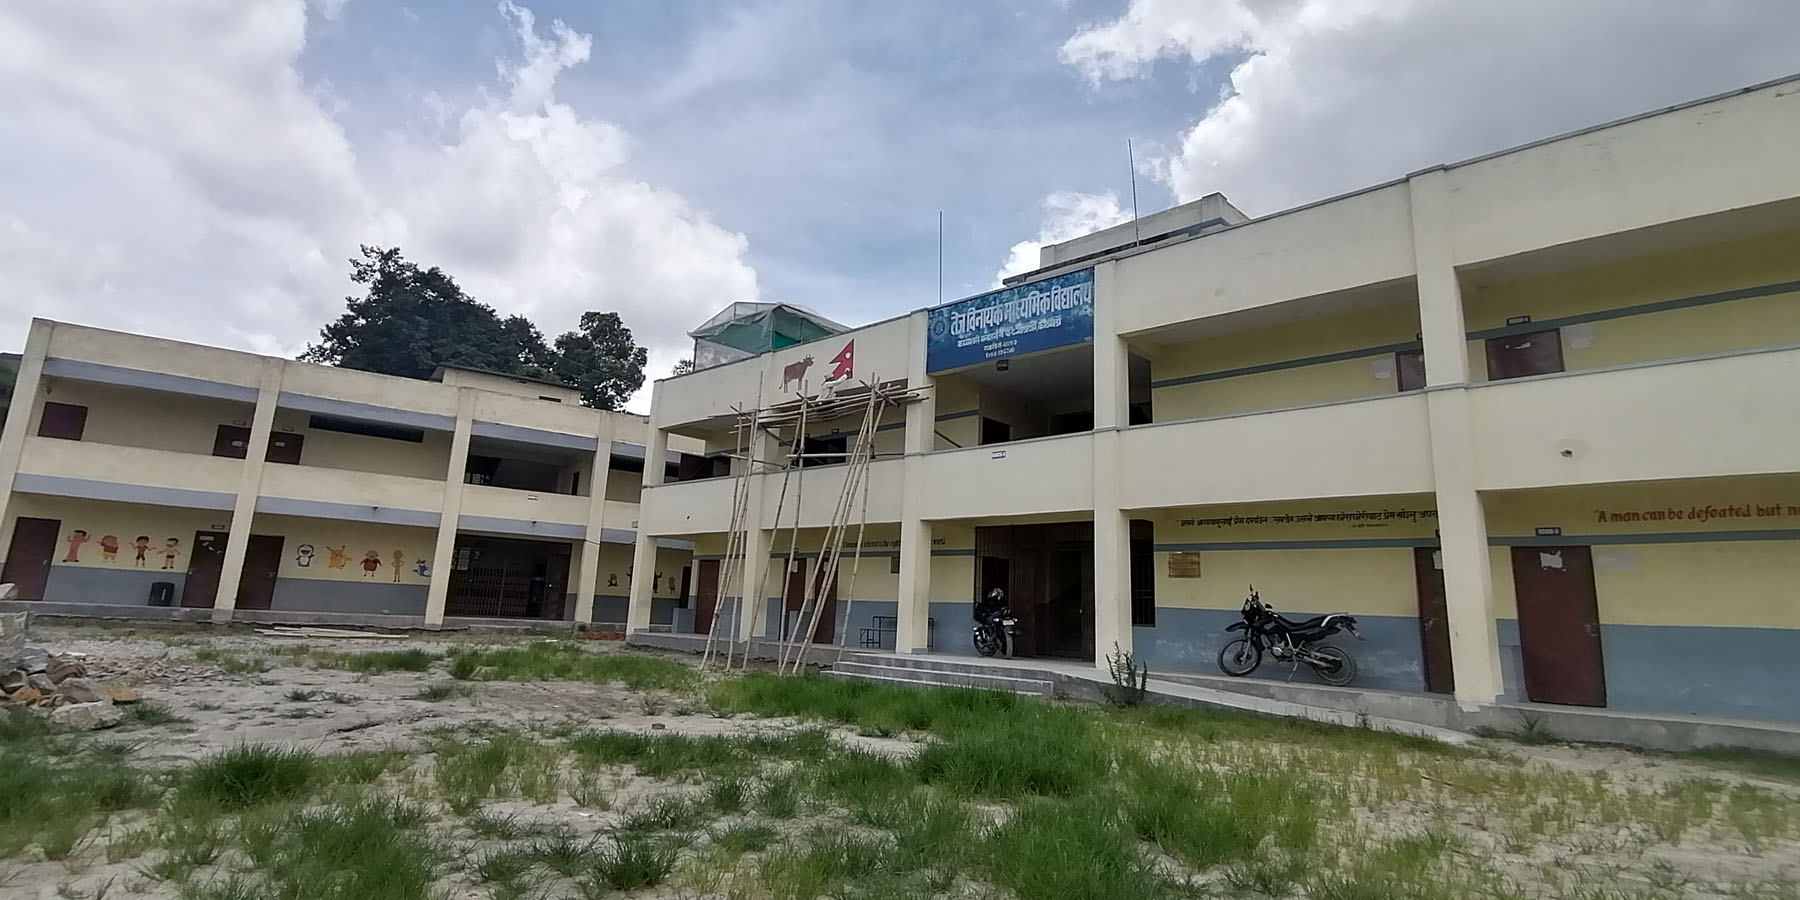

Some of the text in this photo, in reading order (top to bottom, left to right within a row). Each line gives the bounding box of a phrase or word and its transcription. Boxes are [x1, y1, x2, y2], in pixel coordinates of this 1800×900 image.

[950, 311, 966, 336] तेज
[966, 304, 1003, 332] विनायक
[1004, 291, 1051, 323] माध्यमिक
[1051, 281, 1092, 313] विद्यालय
[1610, 511, 1640, 522] man
[1641, 510, 1666, 521] can
[1668, 507, 1684, 520] be
[1687, 503, 1751, 523] defeated
[1756, 503, 1781, 518] but
